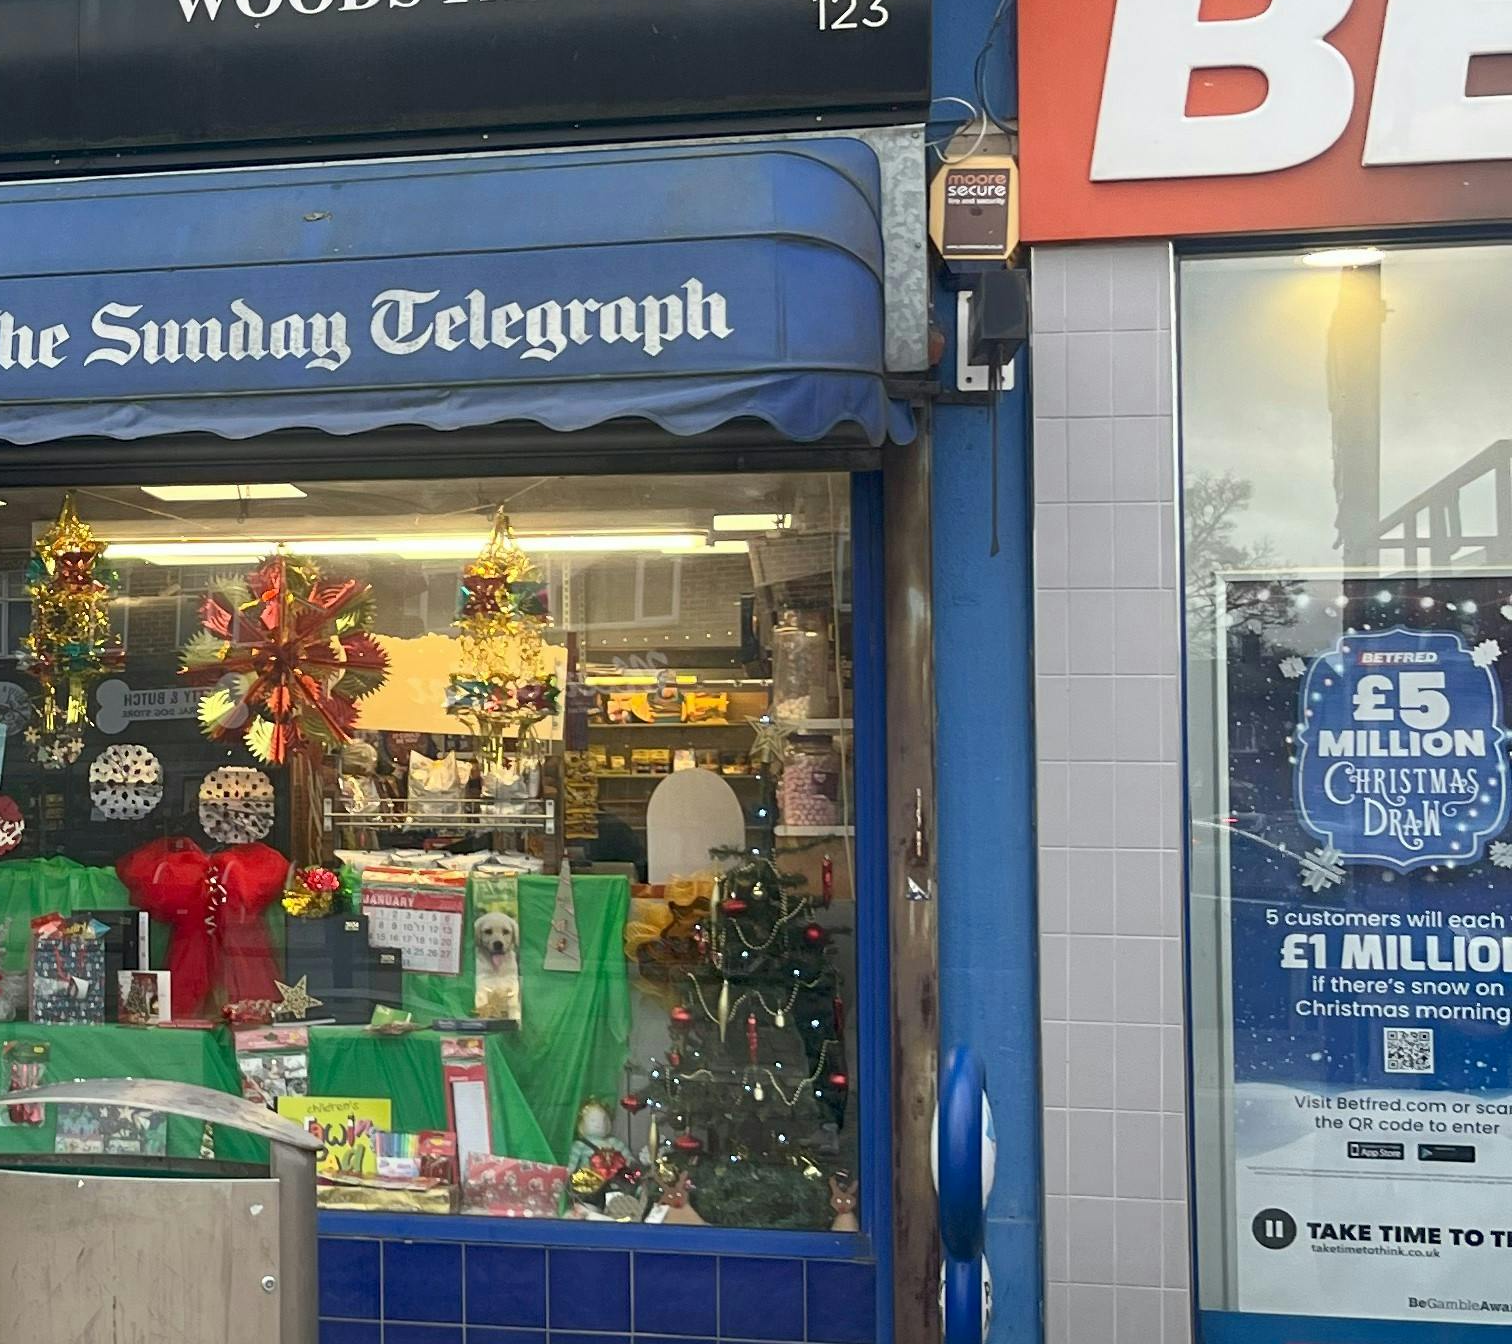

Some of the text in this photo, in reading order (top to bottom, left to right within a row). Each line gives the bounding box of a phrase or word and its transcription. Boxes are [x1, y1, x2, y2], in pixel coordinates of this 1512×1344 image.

[948, 174, 1006, 185] moore
[948, 185, 1006, 196] secure
[84, 298, 352, 372] Sunday
[370, 277, 735, 362] Telegraph
[1360, 651, 1438, 664] BETFRED
[1352, 671, 1451, 730] £5
[1318, 729, 1486, 757] MILLION
[1324, 761, 1480, 817] CHRISTMAS
[1363, 797, 1442, 851] DRAW
[363, 894, 415, 907] JANUARY
[1266, 909, 1279, 925] 5
[1285, 910, 1401, 927] customers
[1407, 910, 1442, 927] will
[1448, 911, 1505, 928] each
[1280, 933, 1512, 972] £1 MILLIO
[1312, 975, 1505, 996] if there's snow on
[1295, 999, 1512, 1025] Christmas morning
[307, 1101, 360, 1113] children's
[1294, 1095, 1512, 1116] Visit Betfred.com or sca
[1315, 1115, 1501, 1134] the QR code to enter
[1306, 1222, 1512, 1248] TAKE TIME TO T
[1311, 1244, 1441, 1257] taketimetothink.co.uk
